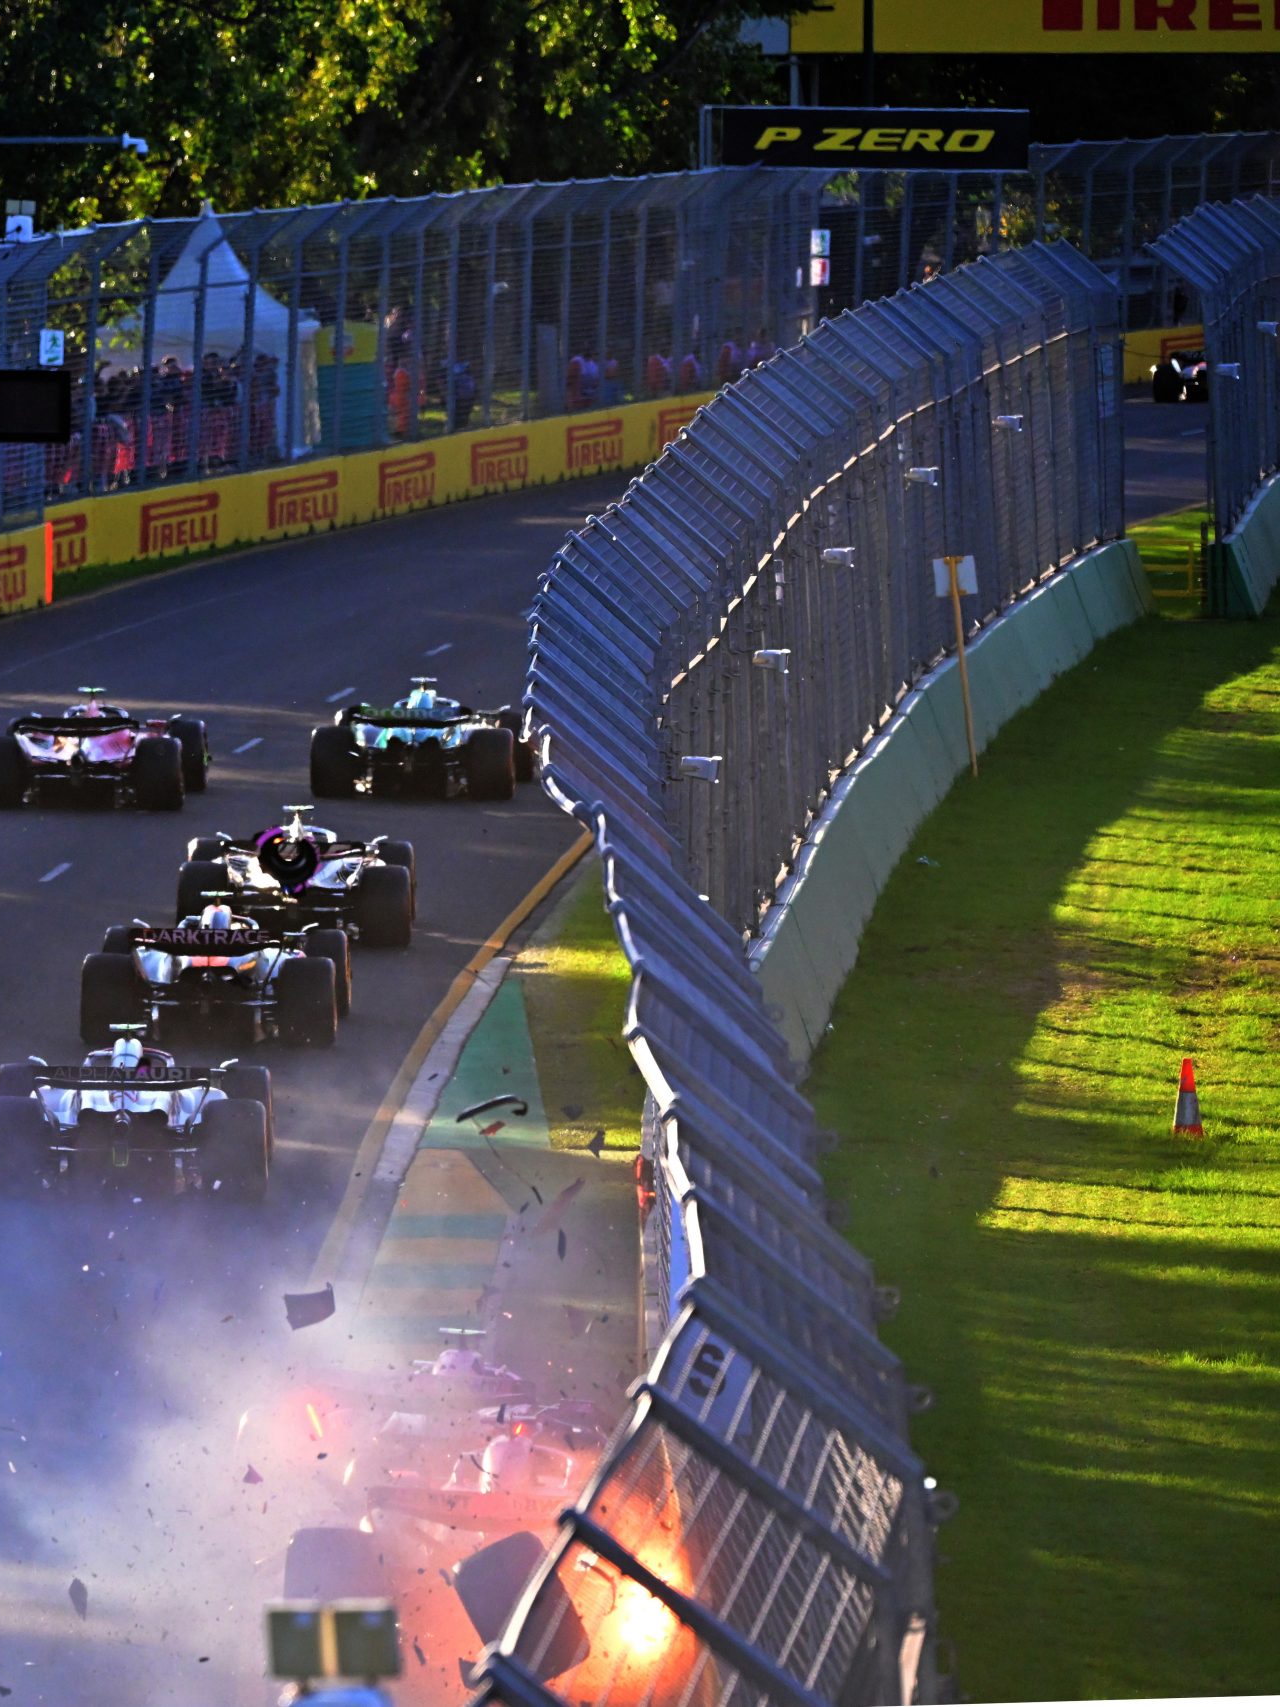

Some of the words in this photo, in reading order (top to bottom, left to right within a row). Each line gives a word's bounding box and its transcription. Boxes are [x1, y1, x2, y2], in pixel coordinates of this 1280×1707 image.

[754, 127, 802, 149] P
[813, 128, 995, 152] ZERO
[472, 436, 528, 486] PIRELLI
[567, 419, 624, 470] PIRELLI
[268, 470, 339, 530] PIRELLI
[379, 452, 436, 509] PIRELLI
[140, 492, 220, 554] PIRELLI
[142, 928, 270, 945] DARKTRACE
